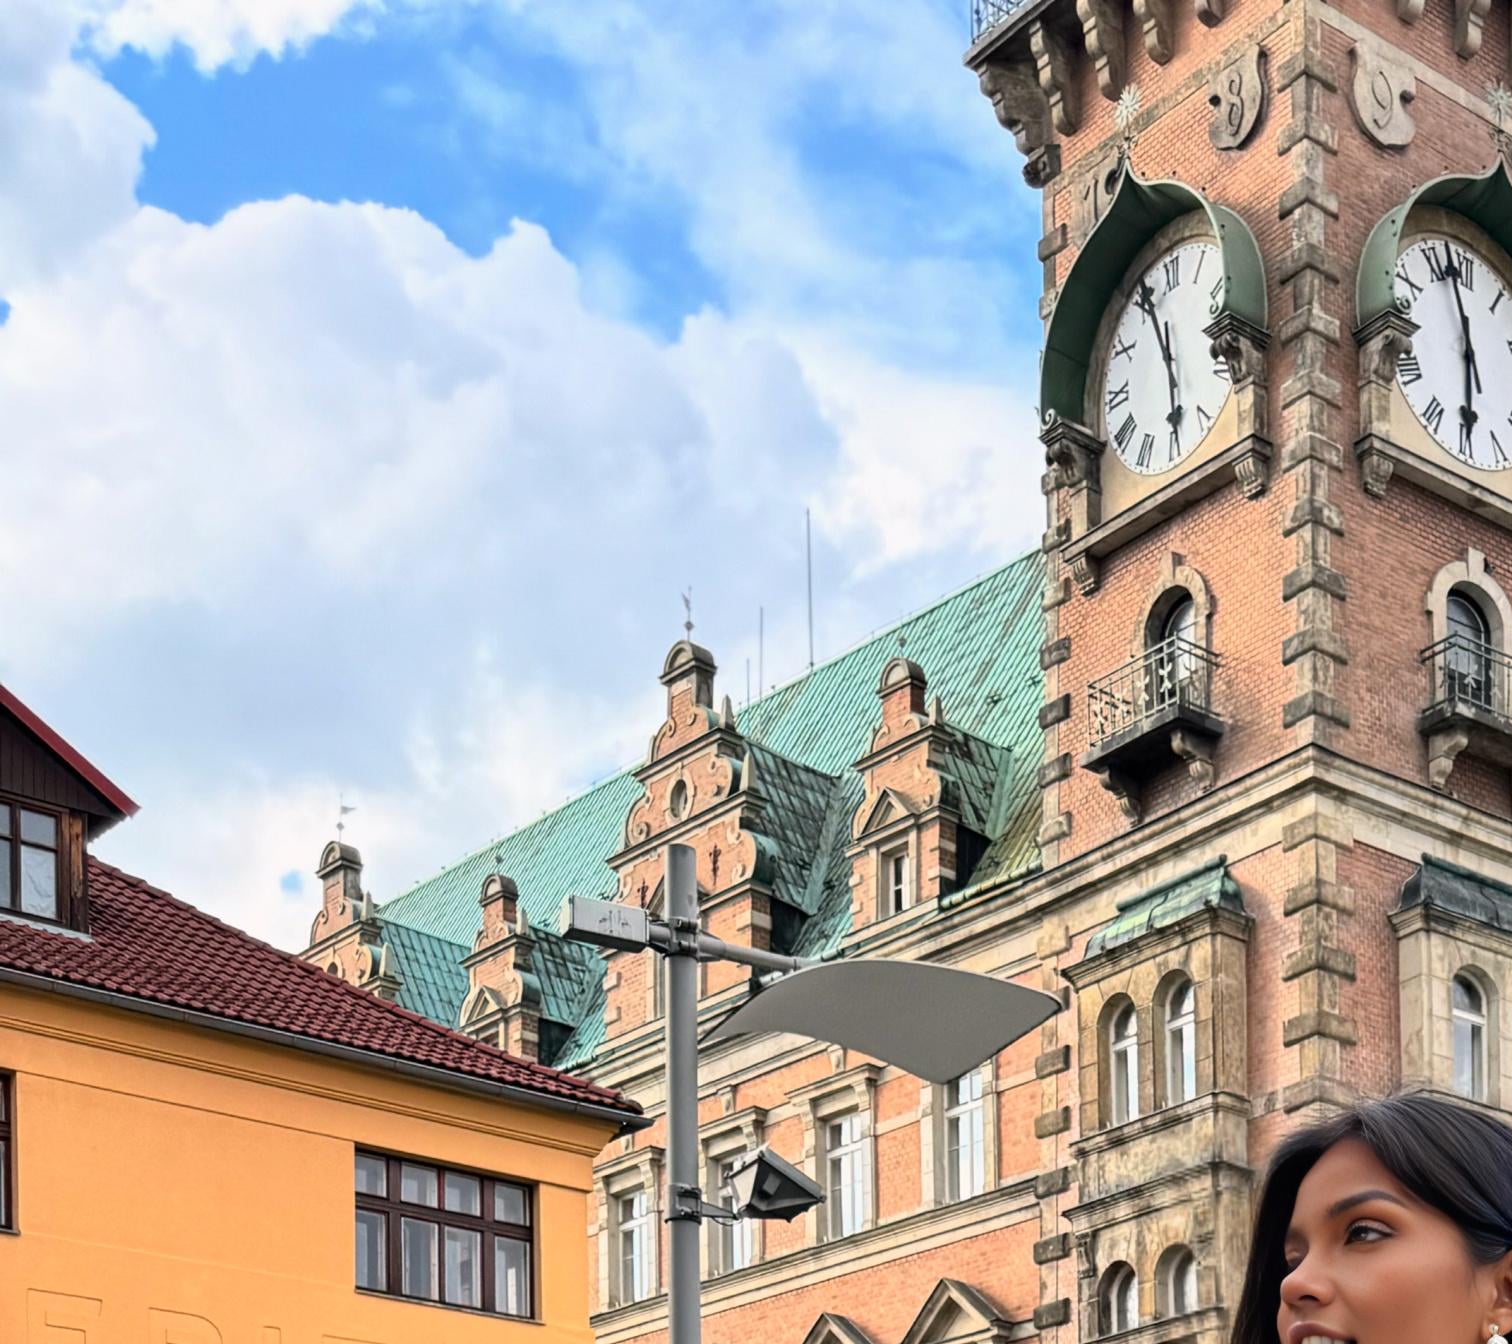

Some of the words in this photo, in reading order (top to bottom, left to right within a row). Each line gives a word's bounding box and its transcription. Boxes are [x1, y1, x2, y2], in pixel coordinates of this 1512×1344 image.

[1162, 255, 1180, 297] XII
[1420, 246, 1446, 283] XI
[1489, 286, 1505, 316] I
[1111, 333, 1137, 364] X
[1421, 394, 1445, 436] VII
[1489, 430, 1509, 465] V
